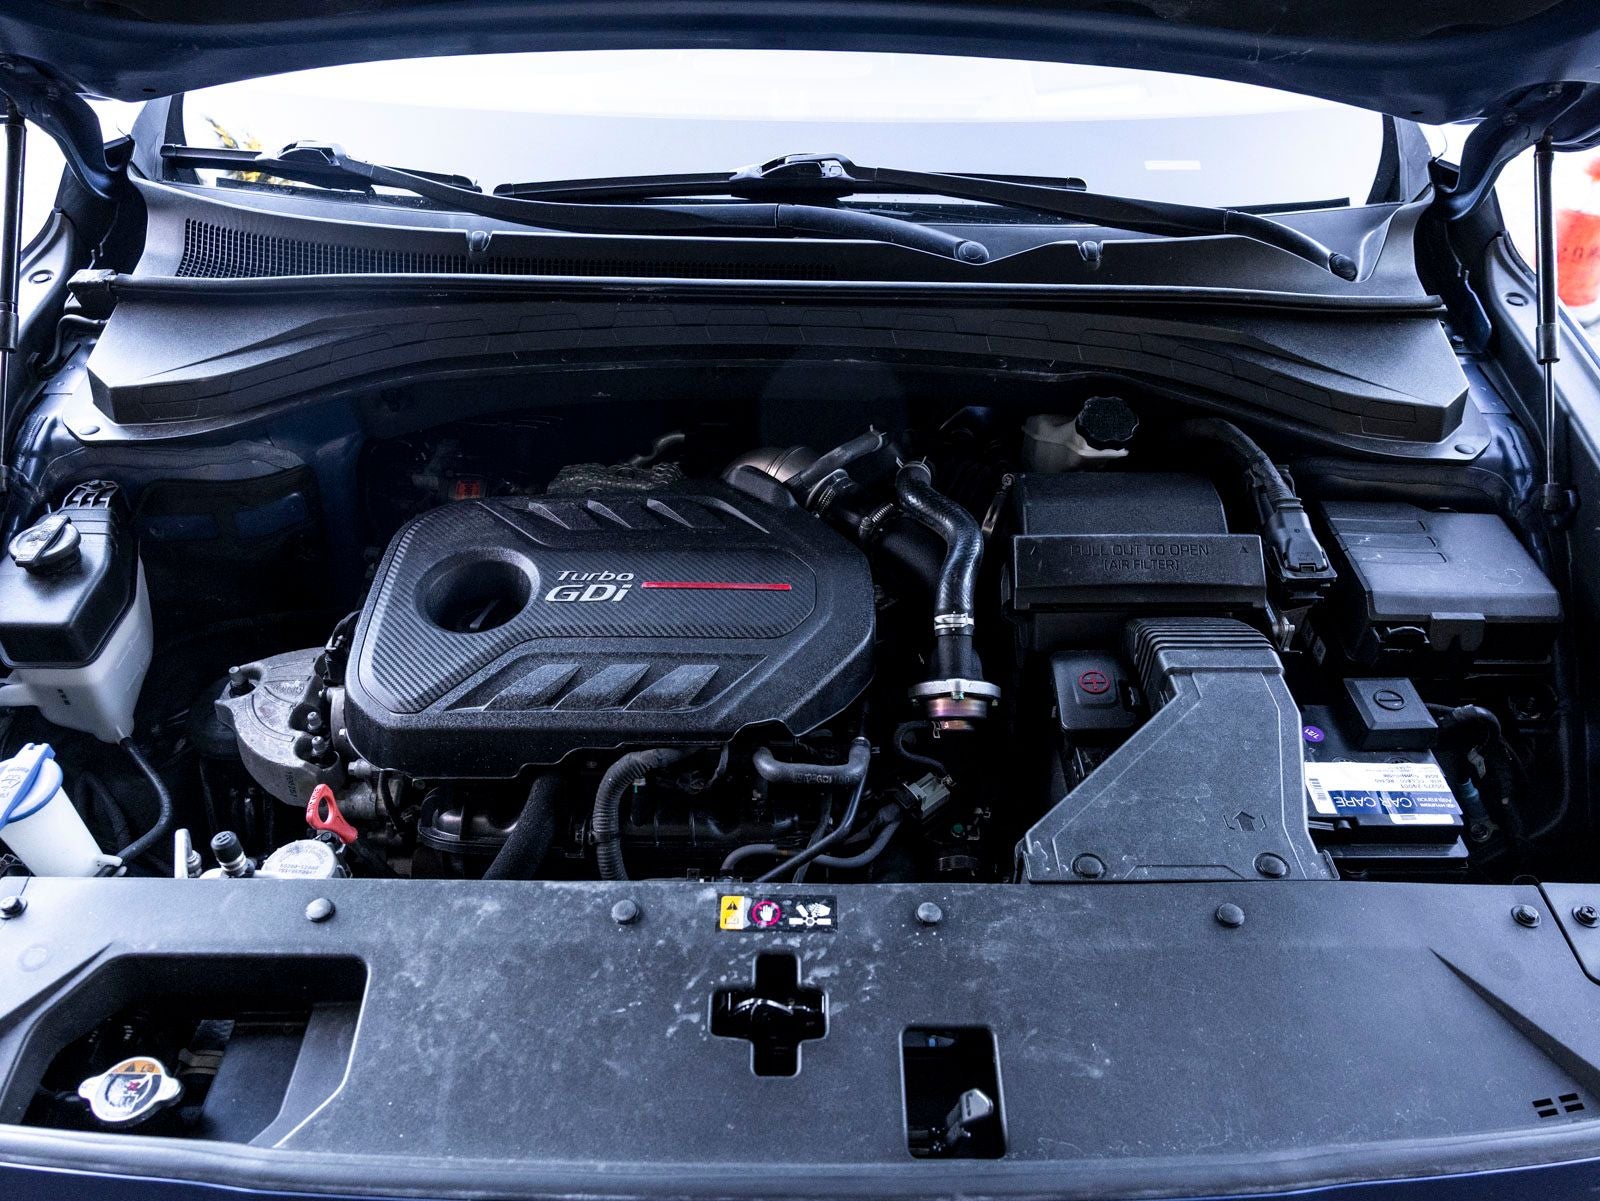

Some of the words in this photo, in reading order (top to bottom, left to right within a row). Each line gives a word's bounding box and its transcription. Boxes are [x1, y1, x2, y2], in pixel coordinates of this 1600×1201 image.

[1069, 543, 1109, 557] PULL
[1111, 543, 1142, 557] OUT
[1147, 543, 1166, 557] TO
[1169, 543, 1210, 557] OPEN
[557, 570, 635, 581] Turbo
[545, 584, 632, 602] GDi
[1335, 796, 1377, 808] CARE
[1381, 796, 1413, 808] CAR
